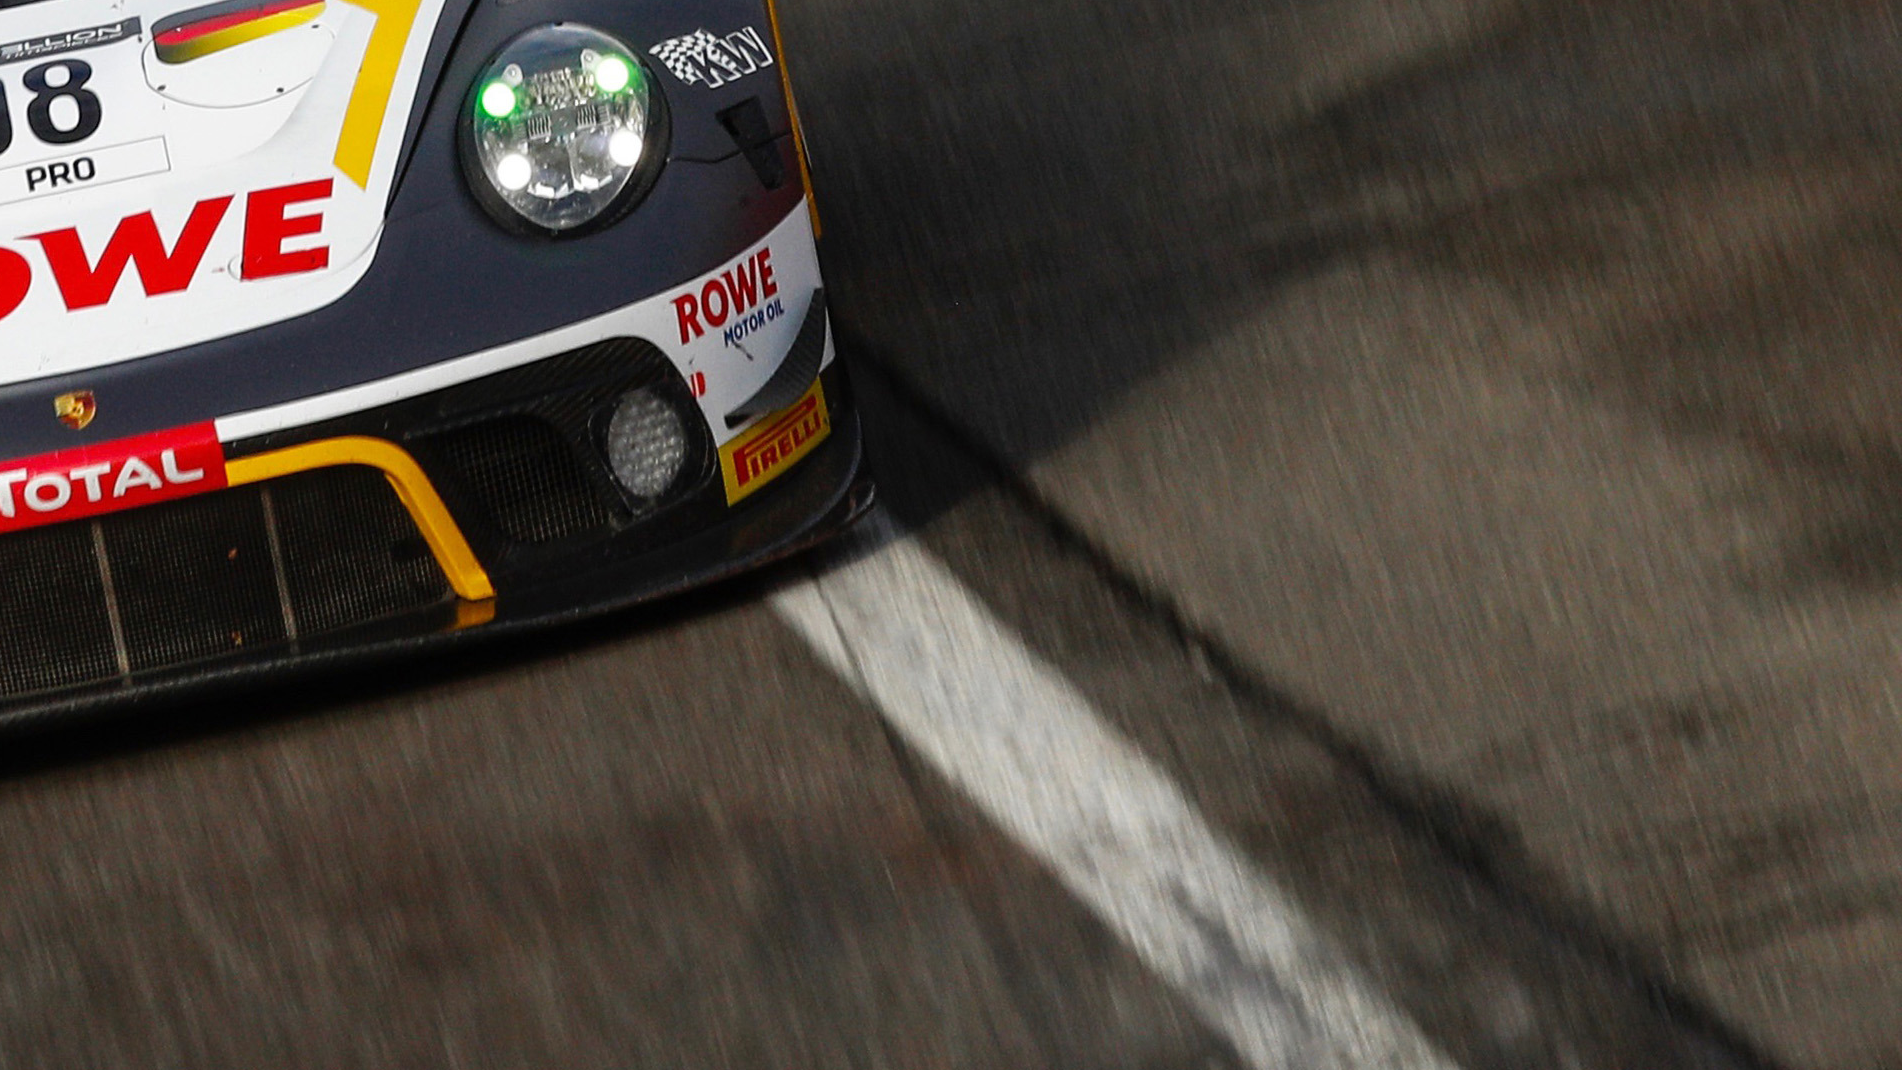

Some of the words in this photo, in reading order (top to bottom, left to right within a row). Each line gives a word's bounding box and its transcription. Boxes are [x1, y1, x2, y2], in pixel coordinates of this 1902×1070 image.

[682, 26, 774, 89] KW
[25, 156, 96, 192] PRO
[671, 246, 778, 346] ROWE
[723, 308, 767, 348] MOTOR
[766, 297, 785, 322] OIL
[732, 393, 822, 488] PIRELLI
